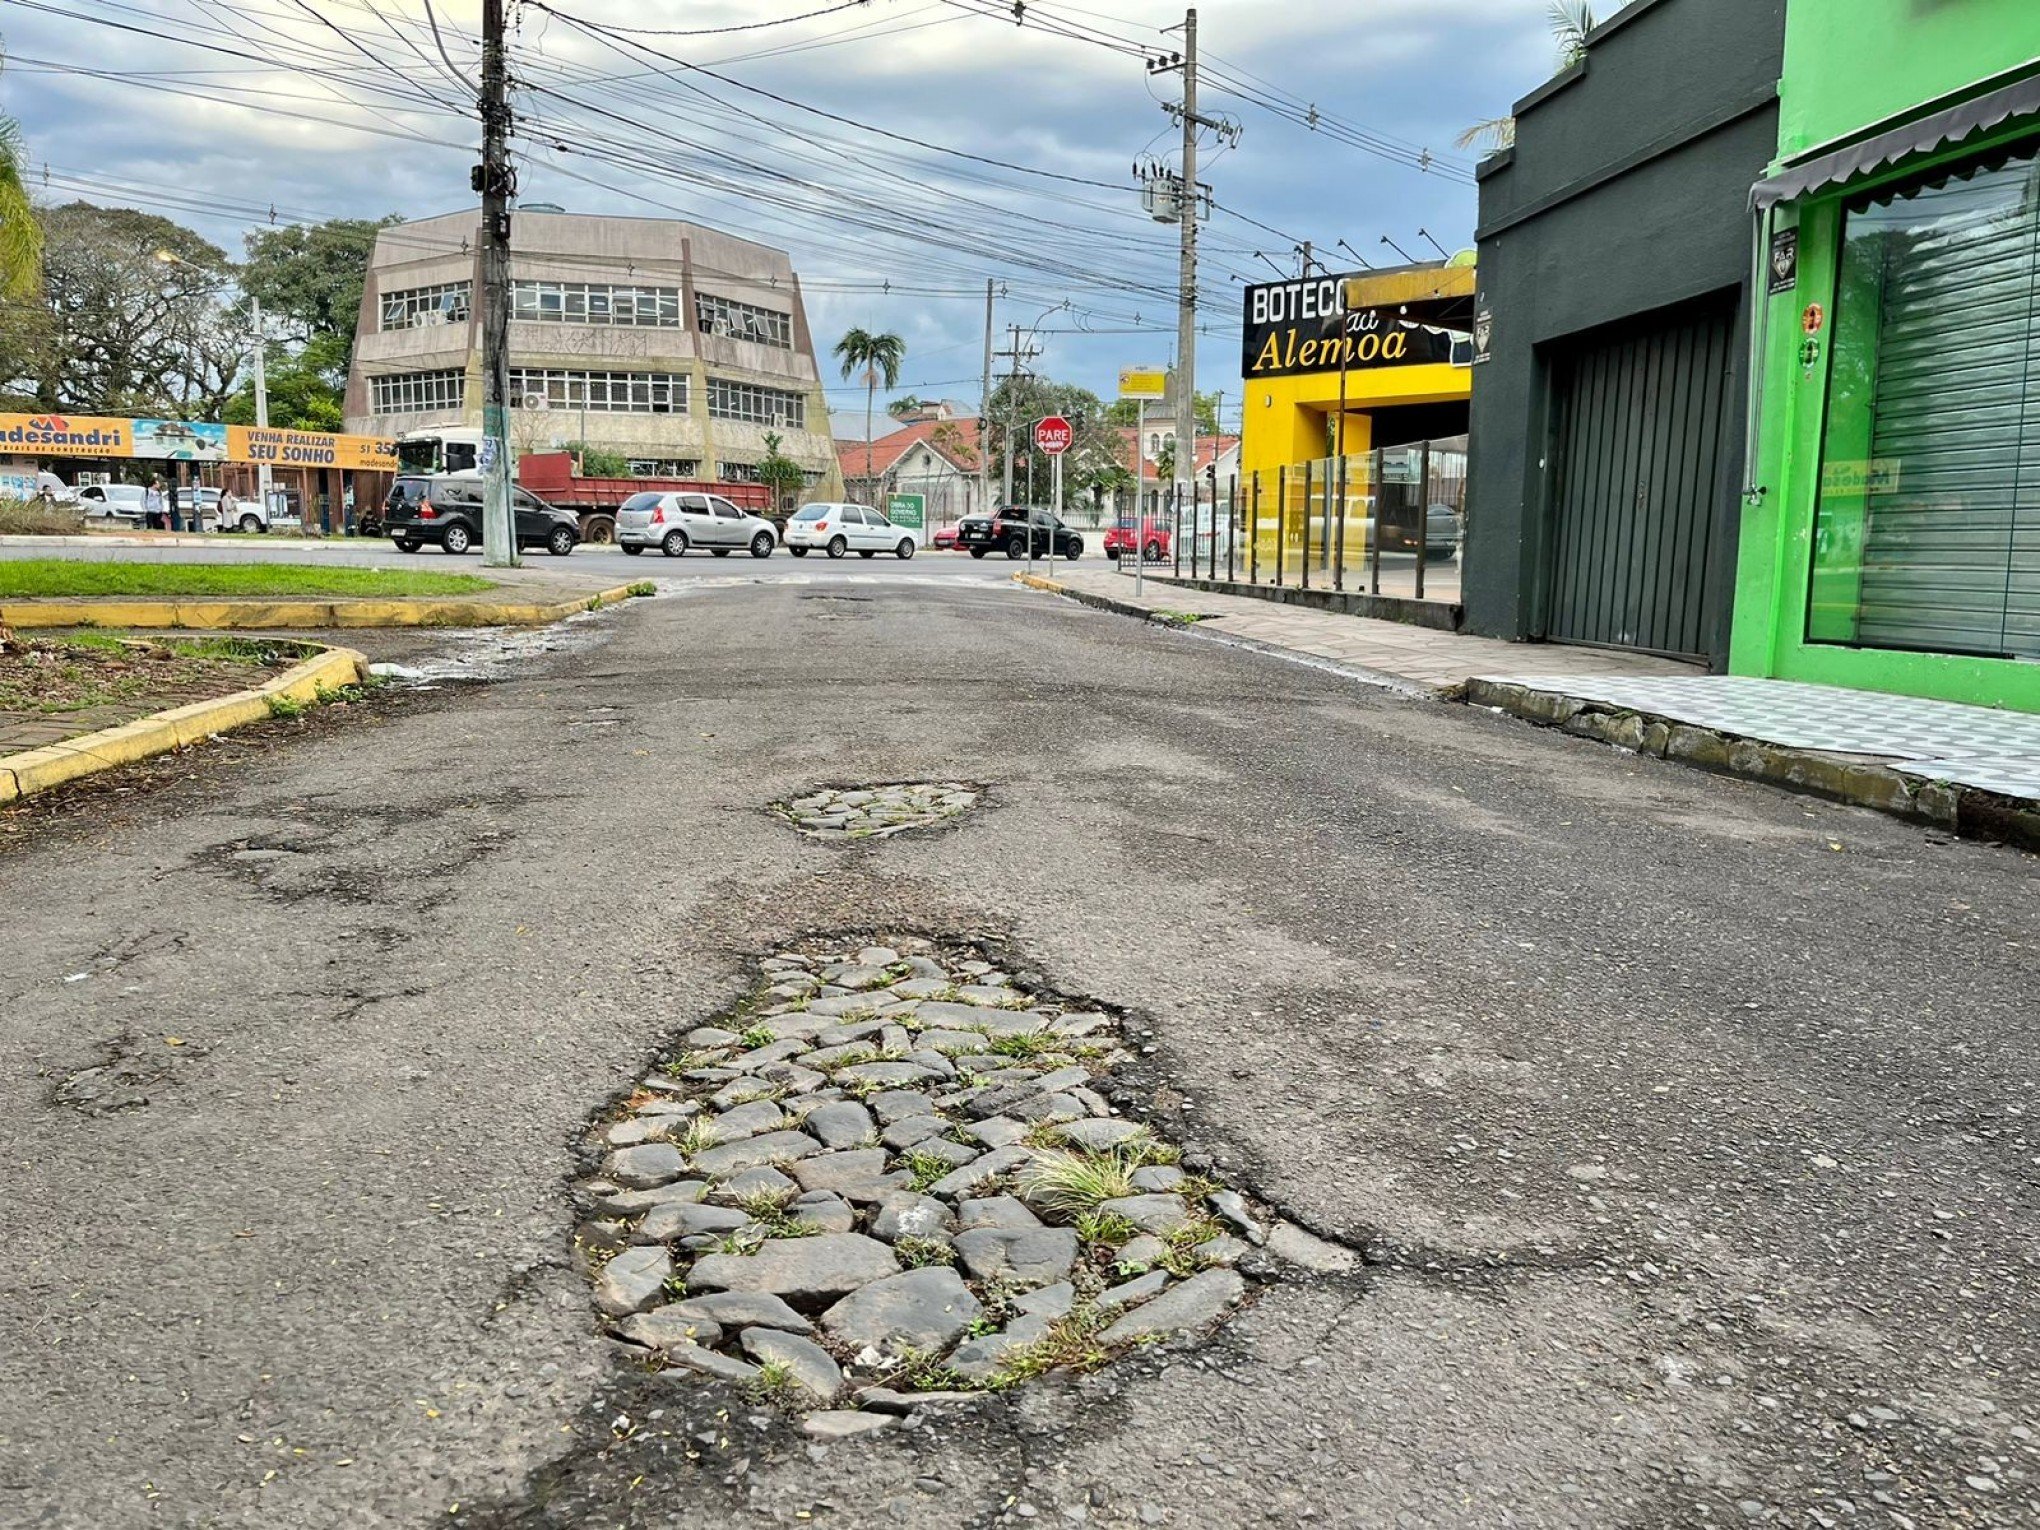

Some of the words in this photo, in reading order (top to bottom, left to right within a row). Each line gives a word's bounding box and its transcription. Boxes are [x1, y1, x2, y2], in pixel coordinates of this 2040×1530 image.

[1252, 328, 1408, 371] Alemoa
[247, 431, 283, 443] VENHA
[286, 434, 335, 447] REALIZAR
[1038, 429, 1069, 441] PARE
[248, 444, 277, 460] SEU
[281, 446, 335, 464] SONHO
